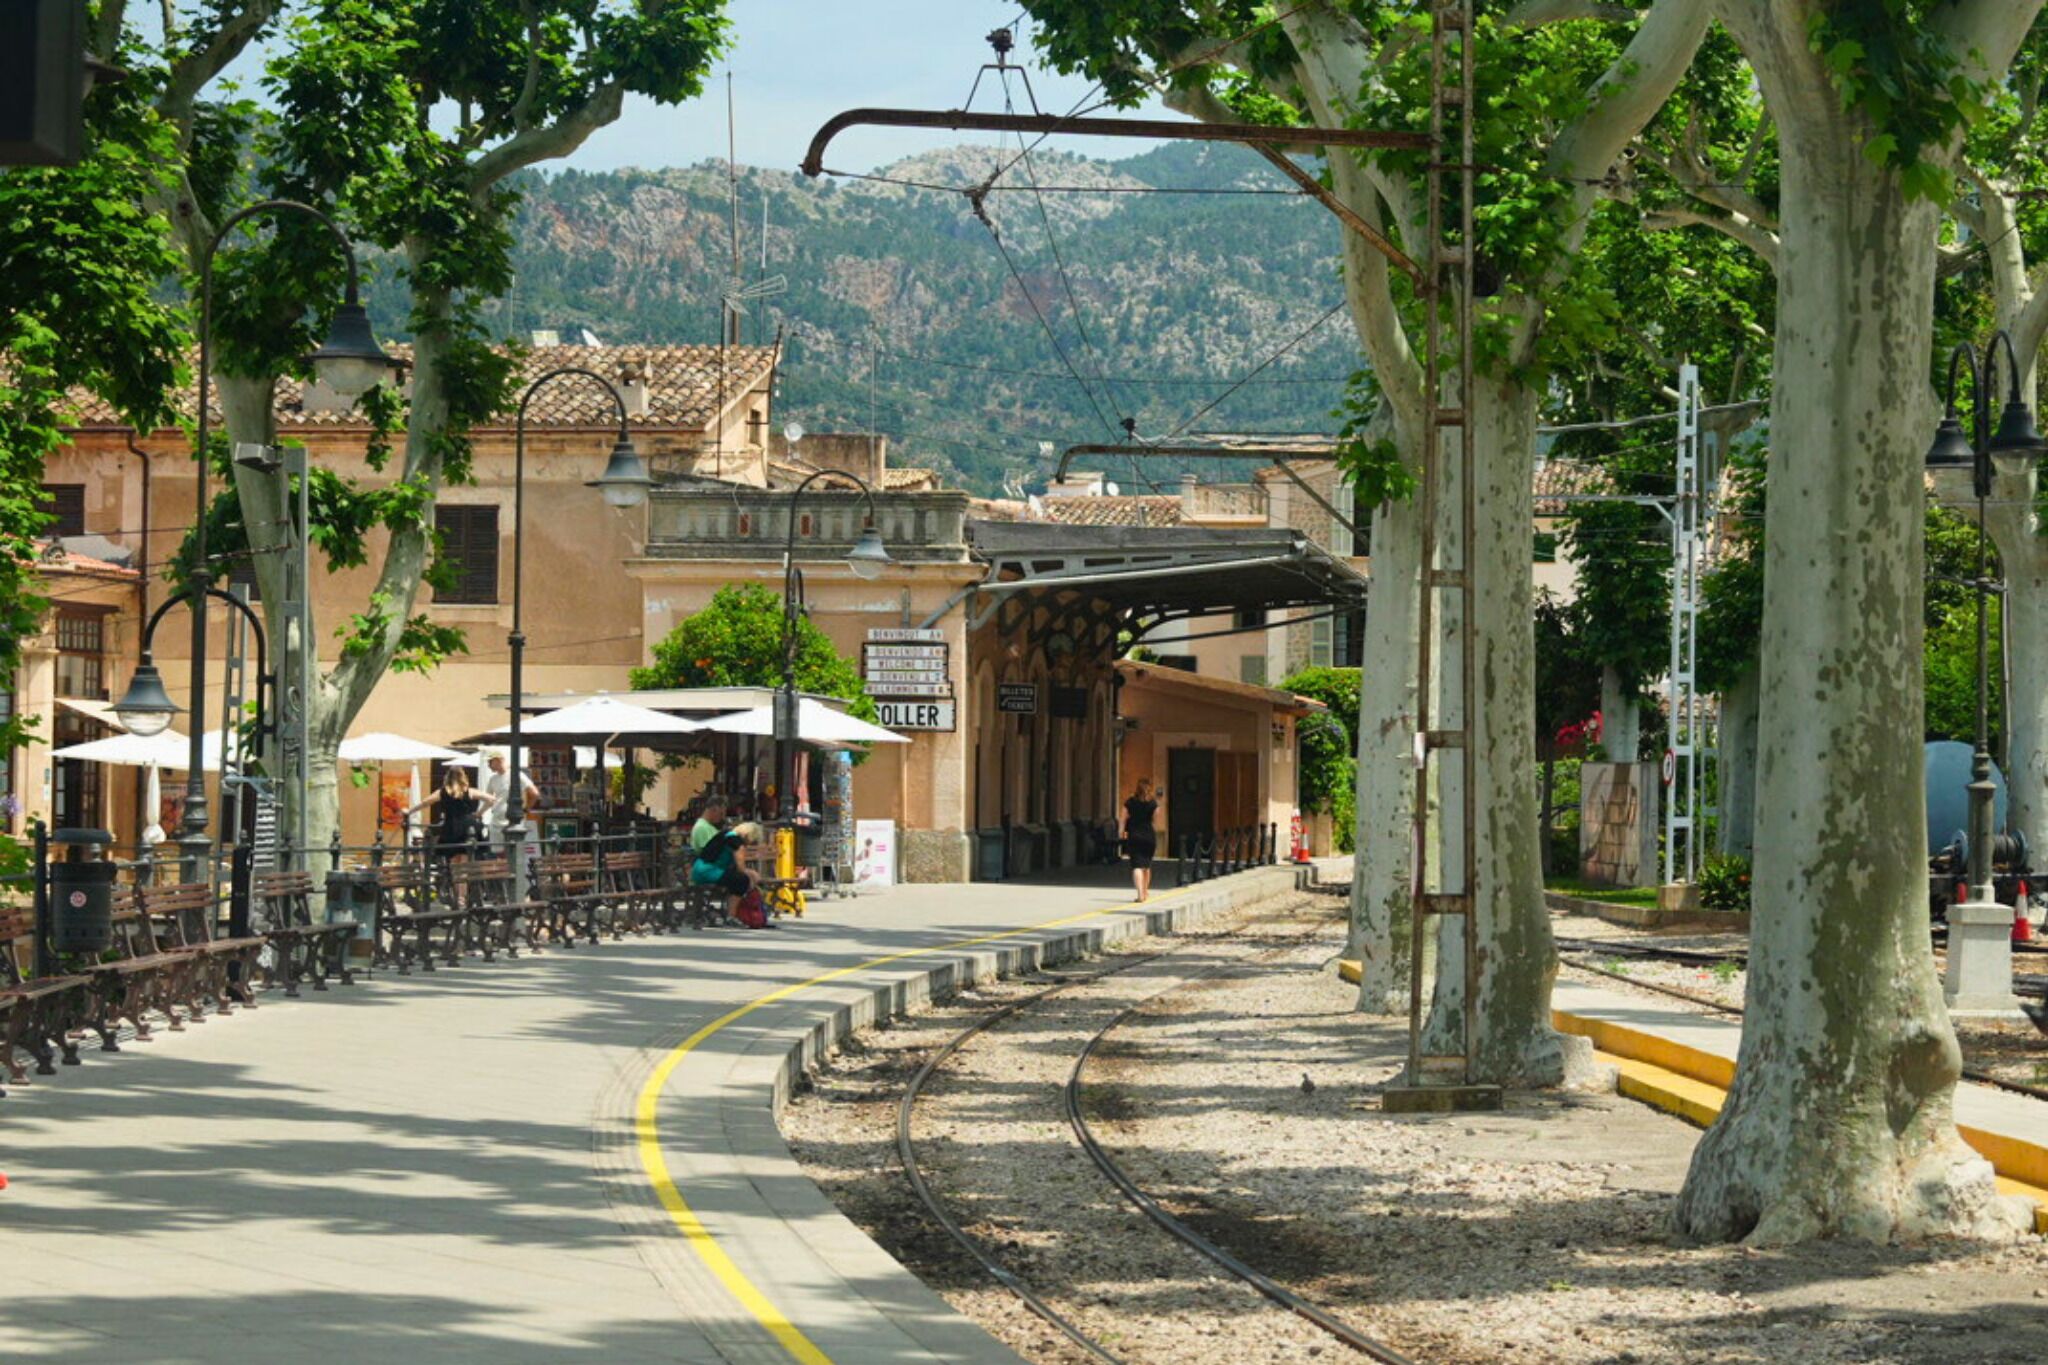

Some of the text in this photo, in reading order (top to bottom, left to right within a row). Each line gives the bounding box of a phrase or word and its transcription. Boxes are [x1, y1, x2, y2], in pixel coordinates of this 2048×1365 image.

[875, 647, 923, 656] BIENVENIDO
[878, 659, 932, 668] WELCOME TO
[866, 685, 918, 694] WILLKOMMEN
